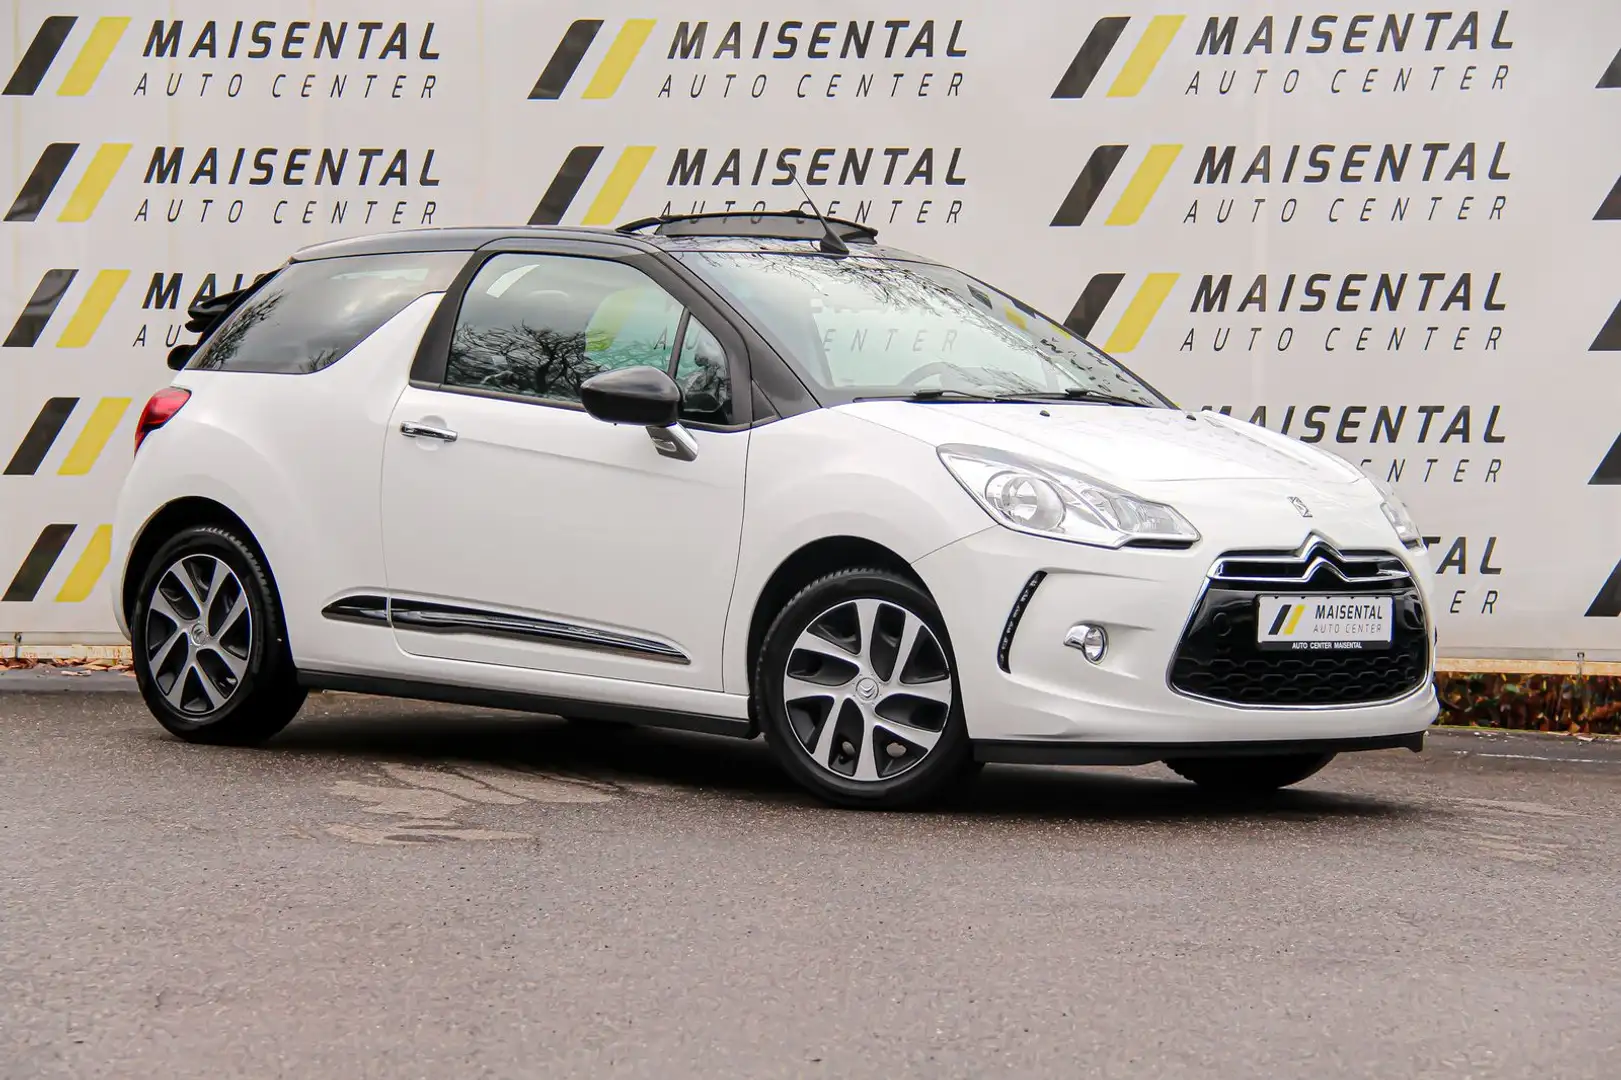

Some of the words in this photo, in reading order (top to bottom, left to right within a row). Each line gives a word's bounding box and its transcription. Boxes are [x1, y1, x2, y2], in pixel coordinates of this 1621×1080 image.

[143, 20, 440, 60] MAISENTAL
[668, 20, 967, 59] MAISENTAL
[1195, 11, 1513, 55] MAISENTAL
[134, 73, 243, 97] AUTO
[272, 74, 437, 98] CENTER
[658, 74, 767, 98] AUTO
[797, 73, 963, 98] CENTER
[1185, 69, 1300, 95] AUTO
[1331, 65, 1509, 94] CENTER
[144, 147, 440, 186] MAISENTAL
[667, 148, 967, 186] MAISENTAL
[1193, 142, 1511, 184] MAISENTAL
[134, 199, 243, 223] AUTO
[273, 200, 437, 225] CENTER
[1184, 198, 1297, 224] AUTO
[1328, 196, 1507, 222] CENTER
[1190, 272, 1506, 312] MAISENTAL
[823, 328, 958, 352] ENTER
[1180, 327, 1294, 352] AUTO
[1325, 326, 1502, 351] CENTER
[1315, 604, 1383, 620] MAISENTAL
[1313, 623, 1340, 634] AUTO
[1345, 623, 1382, 634] CENTER
